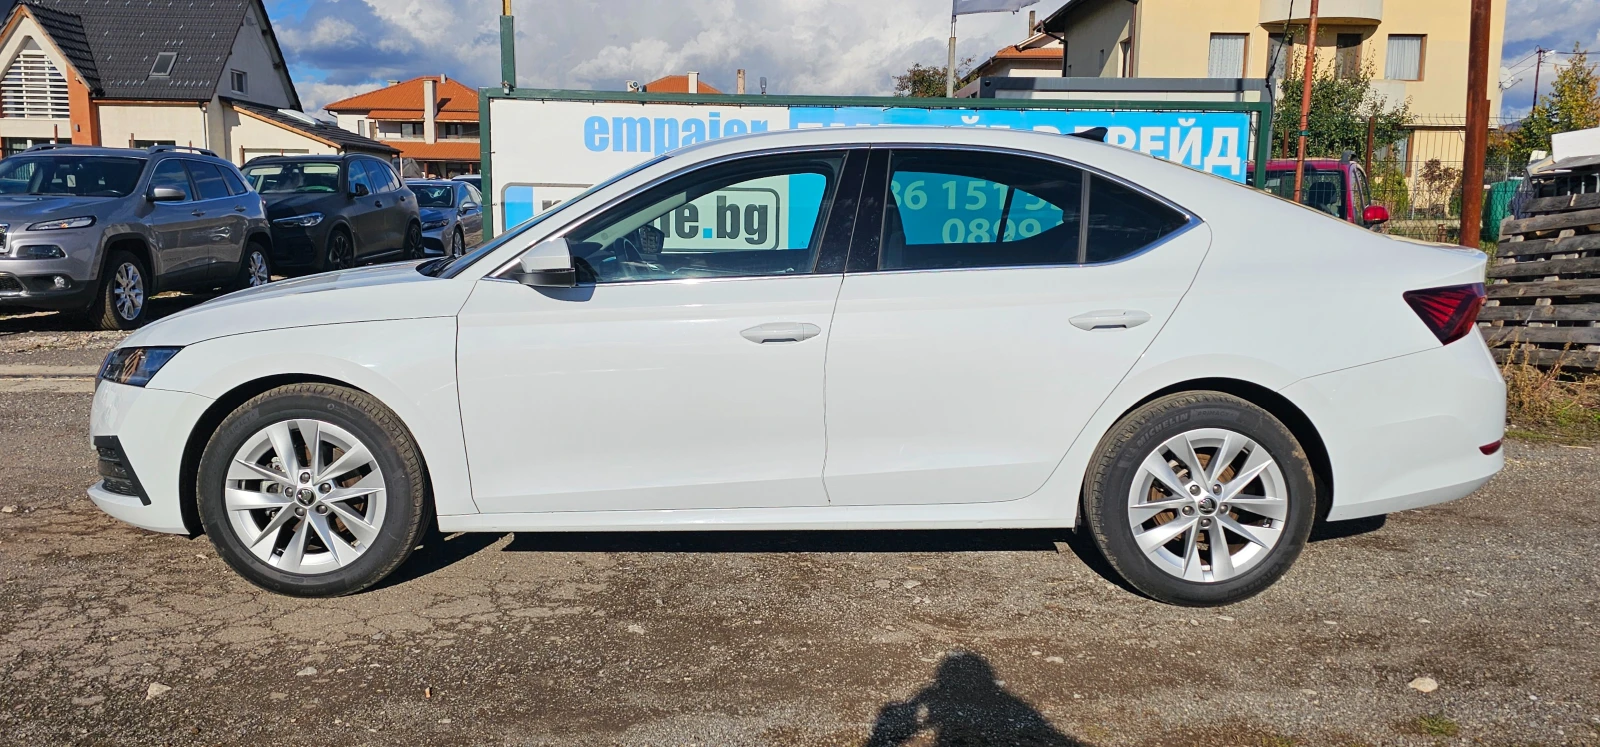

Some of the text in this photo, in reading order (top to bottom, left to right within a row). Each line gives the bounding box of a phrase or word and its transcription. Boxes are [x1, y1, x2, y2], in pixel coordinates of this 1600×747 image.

[1075, 118, 1240, 175] РЕЙД
[942, 181, 1009, 210] 151
[647, 195, 768, 245] le.bg
[1136, 412, 1189, 448] MICHELIN
